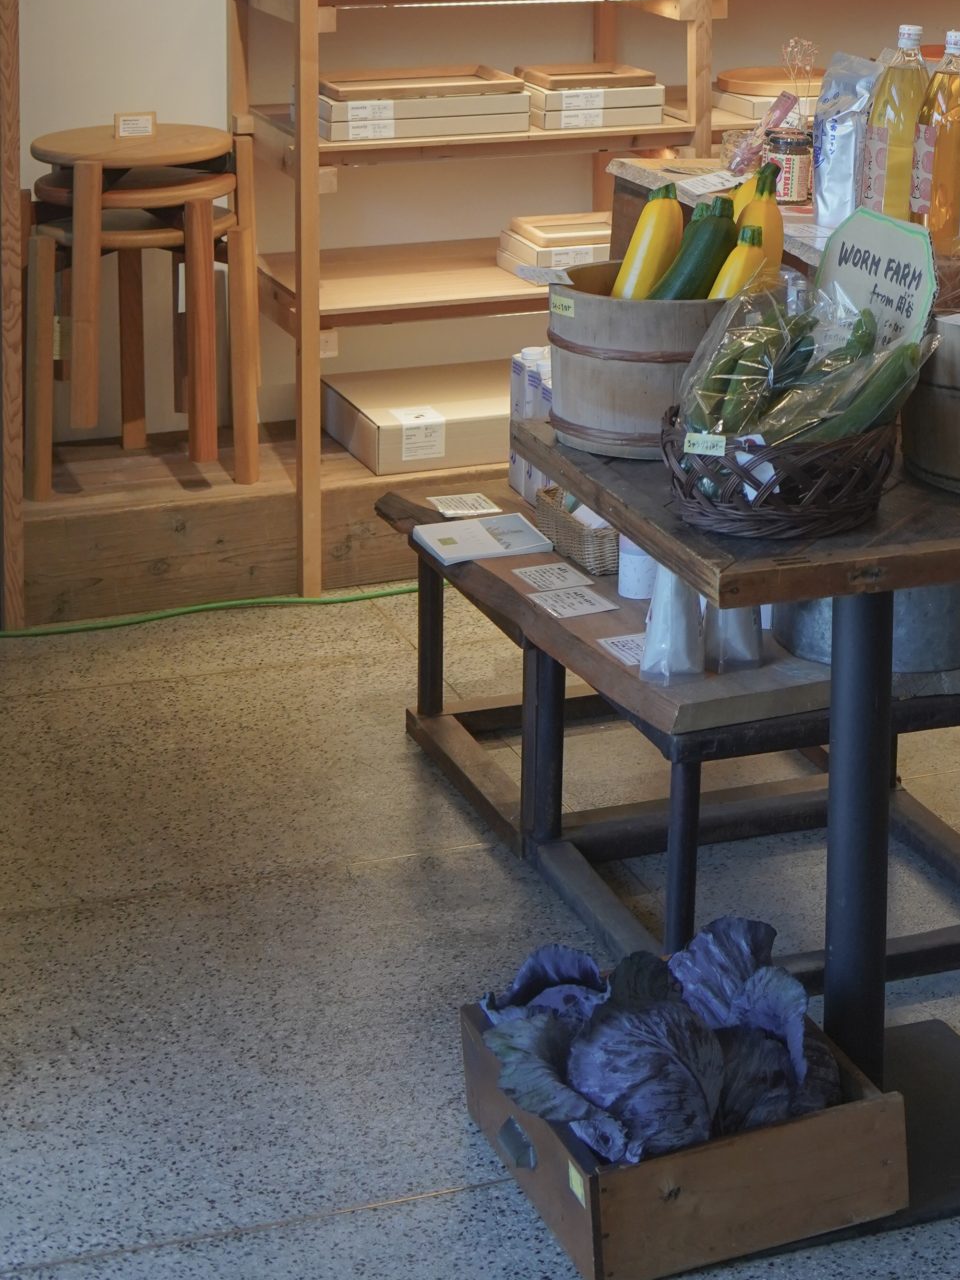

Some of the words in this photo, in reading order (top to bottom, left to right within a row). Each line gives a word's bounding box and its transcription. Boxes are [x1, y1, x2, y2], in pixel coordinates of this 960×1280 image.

[838, 241, 881, 277] WORM
[884, 258, 922, 291] FARM
[869, 283, 894, 309] from
